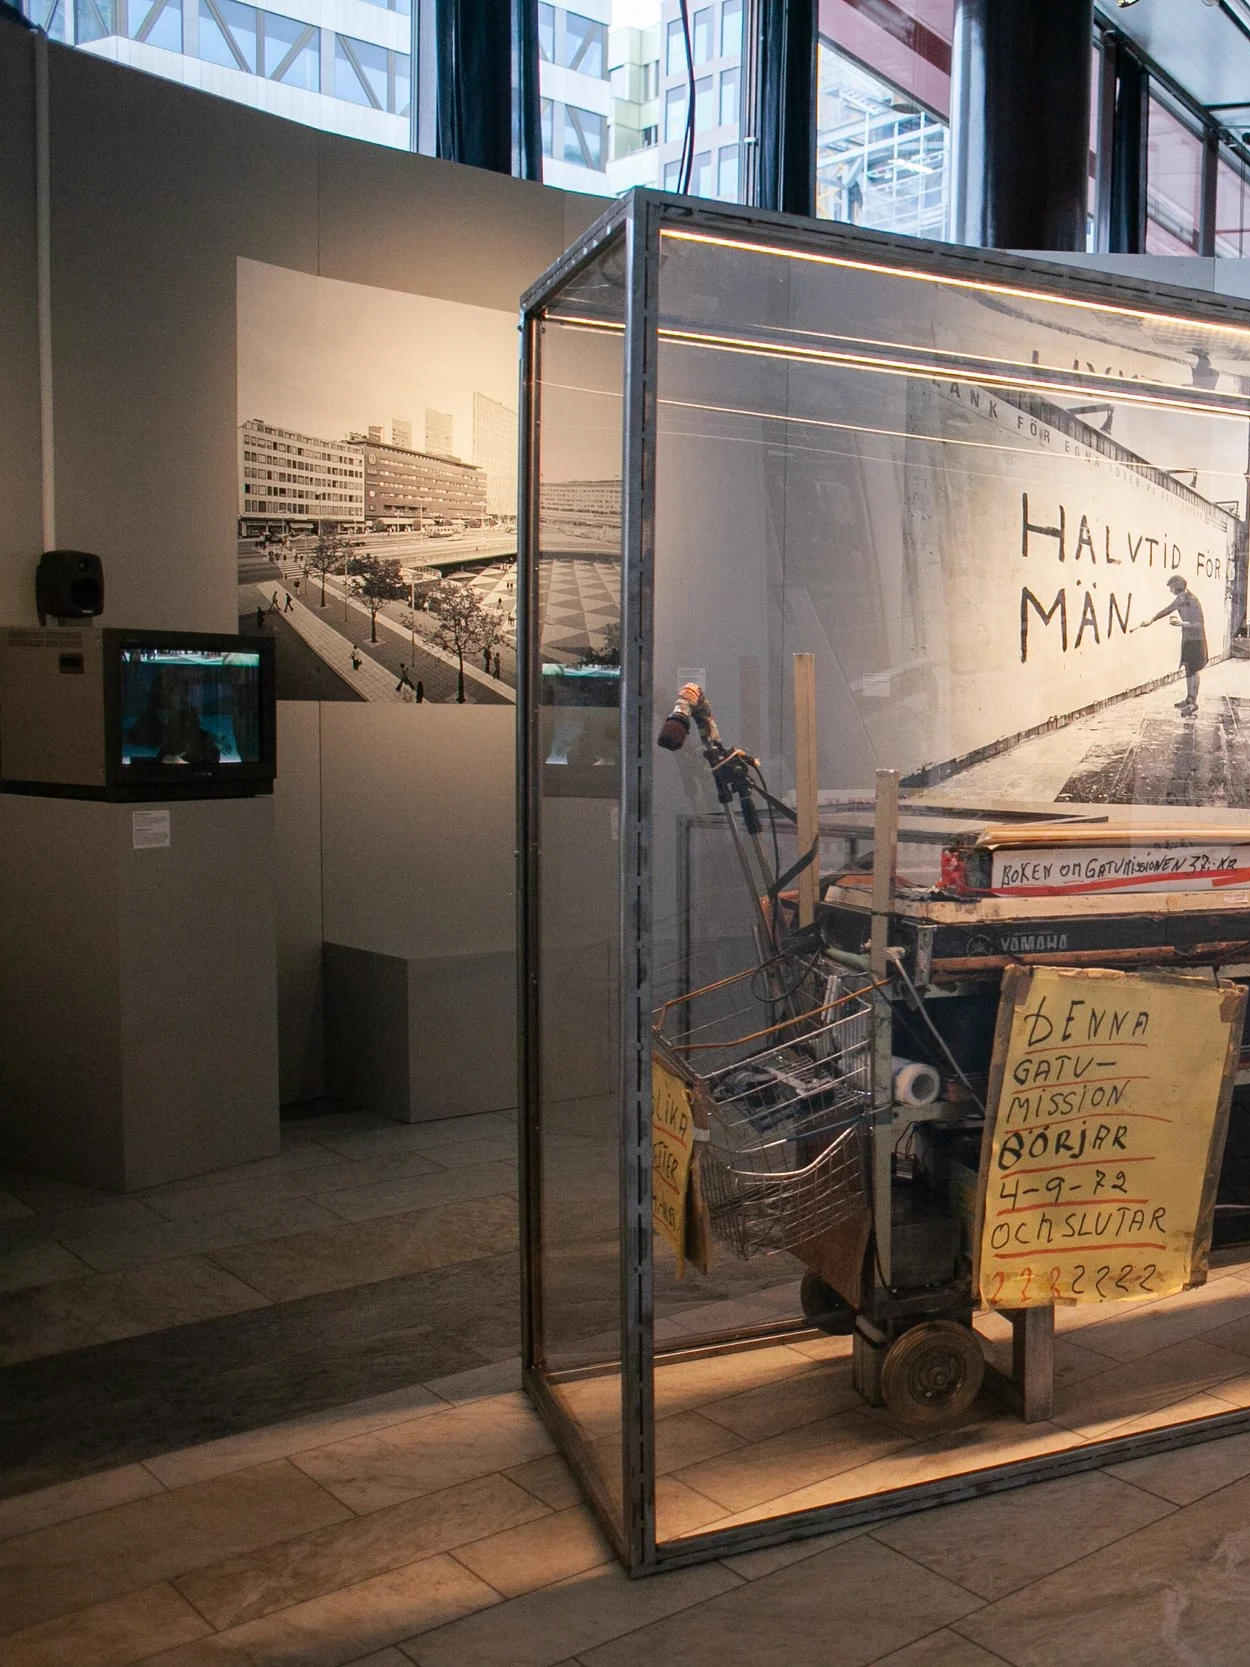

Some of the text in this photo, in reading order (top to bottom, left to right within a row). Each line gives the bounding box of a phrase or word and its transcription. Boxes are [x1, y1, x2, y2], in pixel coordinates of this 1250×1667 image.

[1017, 415, 1051, 444] FÖR
[1109, 465, 1141, 488] IDEER
[1196, 550, 1222, 580] FÖR
[1020, 579, 1133, 664] MÄN
[1001, 862, 1053, 888] BOKEN
[1060, 862, 1082, 878] OM
[1085, 851, 1187, 880] GATUMISSIONEN
[1000, 934, 1068, 951] YAMAHA
[1023, 996, 1149, 1047] DENNA
[1013, 1054, 1117, 1085] GATU-
[651, 1089, 688, 1138] LIKA
[1006, 1079, 1131, 1124] MISSION
[997, 1120, 1128, 1171] BÖRJAR
[1000, 1170, 1129, 1213] 4-9-72
